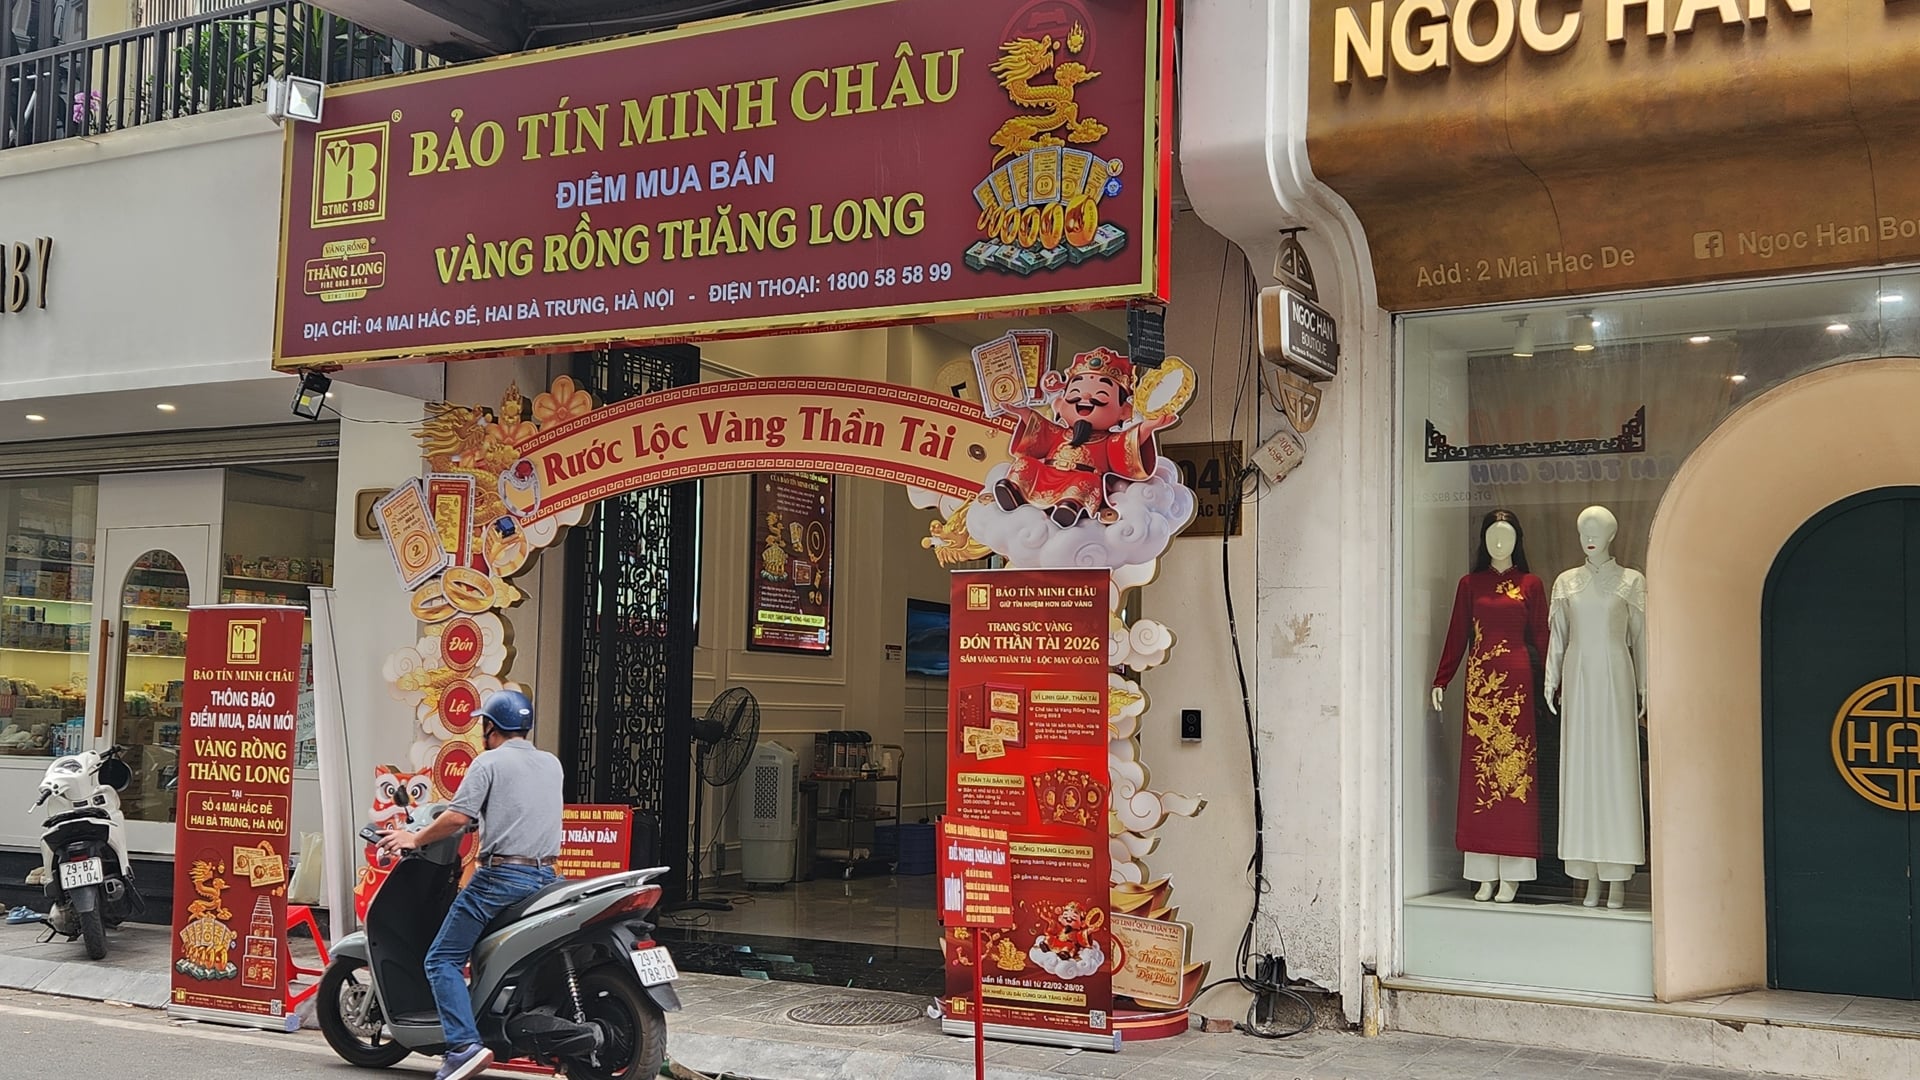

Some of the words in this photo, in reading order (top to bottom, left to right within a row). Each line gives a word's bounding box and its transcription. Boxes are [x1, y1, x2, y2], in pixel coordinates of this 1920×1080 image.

[1333, 0, 1582, 83] NGOC
[408, 108, 505, 176] BẢO
[517, 97, 609, 161] TÍN
[619, 77, 778, 147] MINH
[790, 41, 964, 121] CHÂU
[556, 171, 627, 209] ĐIỂM
[635, 165, 702, 200] MUA
[709, 150, 775, 190] BÁN
[322, 203, 349, 216] BTMC
[352, 199, 375, 212] 1989
[434, 234, 533, 284] VÀNG
[543, 212, 650, 273] RỒNG
[657, 204, 797, 260] THĂNG
[808, 192, 925, 244] LONG
[1738, 230, 1808, 259] Ngoc
[1816, 222, 1870, 247] Han
[307, 264, 348, 281] THĂNG
[350, 261, 383, 277] LONG
[1477, 259, 1491, 282] 2
[1497, 255, 1539, 280] Mai
[1545, 252, 1593, 274] Hac
[1600, 246, 1635, 268] De
[0, 236, 53, 313] BY
[303, 323, 328, 342] ĐỊA
[332, 315, 362, 336] CHỈ:
[365, 318, 383, 333] 04
[386, 314, 414, 332] MAI
[418, 308, 451, 329] HẮC
[485, 304, 513, 322] HAI
[517, 299, 541, 320] BÀ
[544, 296, 609, 317] TRƯNG,
[615, 289, 639, 311] HÀ
[643, 289, 674, 311] NỘI
[708, 281, 751, 304] ĐIỆN
[757, 276, 820, 298] THOẠI:
[827, 271, 869, 292] 1800
[874, 268, 896, 287] 58
[902, 265, 923, 284] 58
[929, 262, 952, 282] 99
[1292, 301, 1316, 332] NGOC
[1316, 315, 1333, 342] HAN
[1301, 331, 1327, 357] BOUTIQUE
[542, 439, 624, 486] Rước
[632, 422, 689, 460] Lộc
[698, 410, 787, 448] Vàng
[798, 407, 885, 448] Thần
[899, 415, 957, 461] Tài
[995, 586, 1016, 597] BẢO
[1017, 585, 1035, 597] TÍN
[1038, 588, 1065, 597] MINH
[1067, 585, 1097, 597] CHÂU
[1074, 600, 1092, 608] VÀNG
[987, 623, 1021, 632] TRANG
[1022, 620, 1043, 632] SỨC
[1045, 620, 1073, 632] VÀNG
[448, 636, 474, 651] Đón
[959, 634, 991, 650] ĐÓN
[994, 633, 1033, 650] THẦN
[1035, 634, 1060, 650] TÀI
[1064, 636, 1100, 650] 2026
[978, 654, 998, 663] VÀNG
[1020, 655, 1031, 663] TÀI
[1037, 656, 1052, 664] LỘC
[193, 668, 214, 681] BẢO
[215, 667, 234, 681] TÍN
[235, 670, 263, 681] MINH
[265, 668, 295, 682] CHÂU
[210, 687, 249, 707] THÔNG
[251, 688, 276, 708] BÁO
[449, 698, 470, 716] Lộc
[189, 706, 217, 728] ĐIỂM
[218, 713, 245, 731] MUA,
[247, 709, 271, 730] BÁN
[273, 711, 294, 731] MỚI
[194, 735, 237, 758] VÀNG
[240, 736, 287, 760] RỒNG
[188, 760, 241, 782] THĂNG
[245, 765, 290, 784] LONG
[232, 790, 242, 799] TẠI
[202, 797, 214, 811] SỐ
[215, 802, 221, 811] 4
[222, 802, 237, 812] MAI
[239, 799, 258, 813] HẮC
[190, 815, 205, 826] HAI
[206, 814, 218, 826] BÀ
[220, 815, 251, 830] TRƯNG,
[252, 816, 266, 829] HÀ
[267, 818, 284, 831] NỘI
[580, 810, 591, 819] HAI
[592, 809, 602, 820] BÀ
[568, 826, 595, 842] NHÂN
[596, 827, 618, 843] DÂN
[975, 846, 993, 864] NHÂN
[64, 872, 99, 887] 131.04
[638, 950, 667, 967] 29-AC
[641, 965, 676, 984] 788.20
[1005, 977, 1020, 986] thần
[1022, 979, 1032, 987] tài
[1042, 981, 1084, 992] 22/02-28/02
